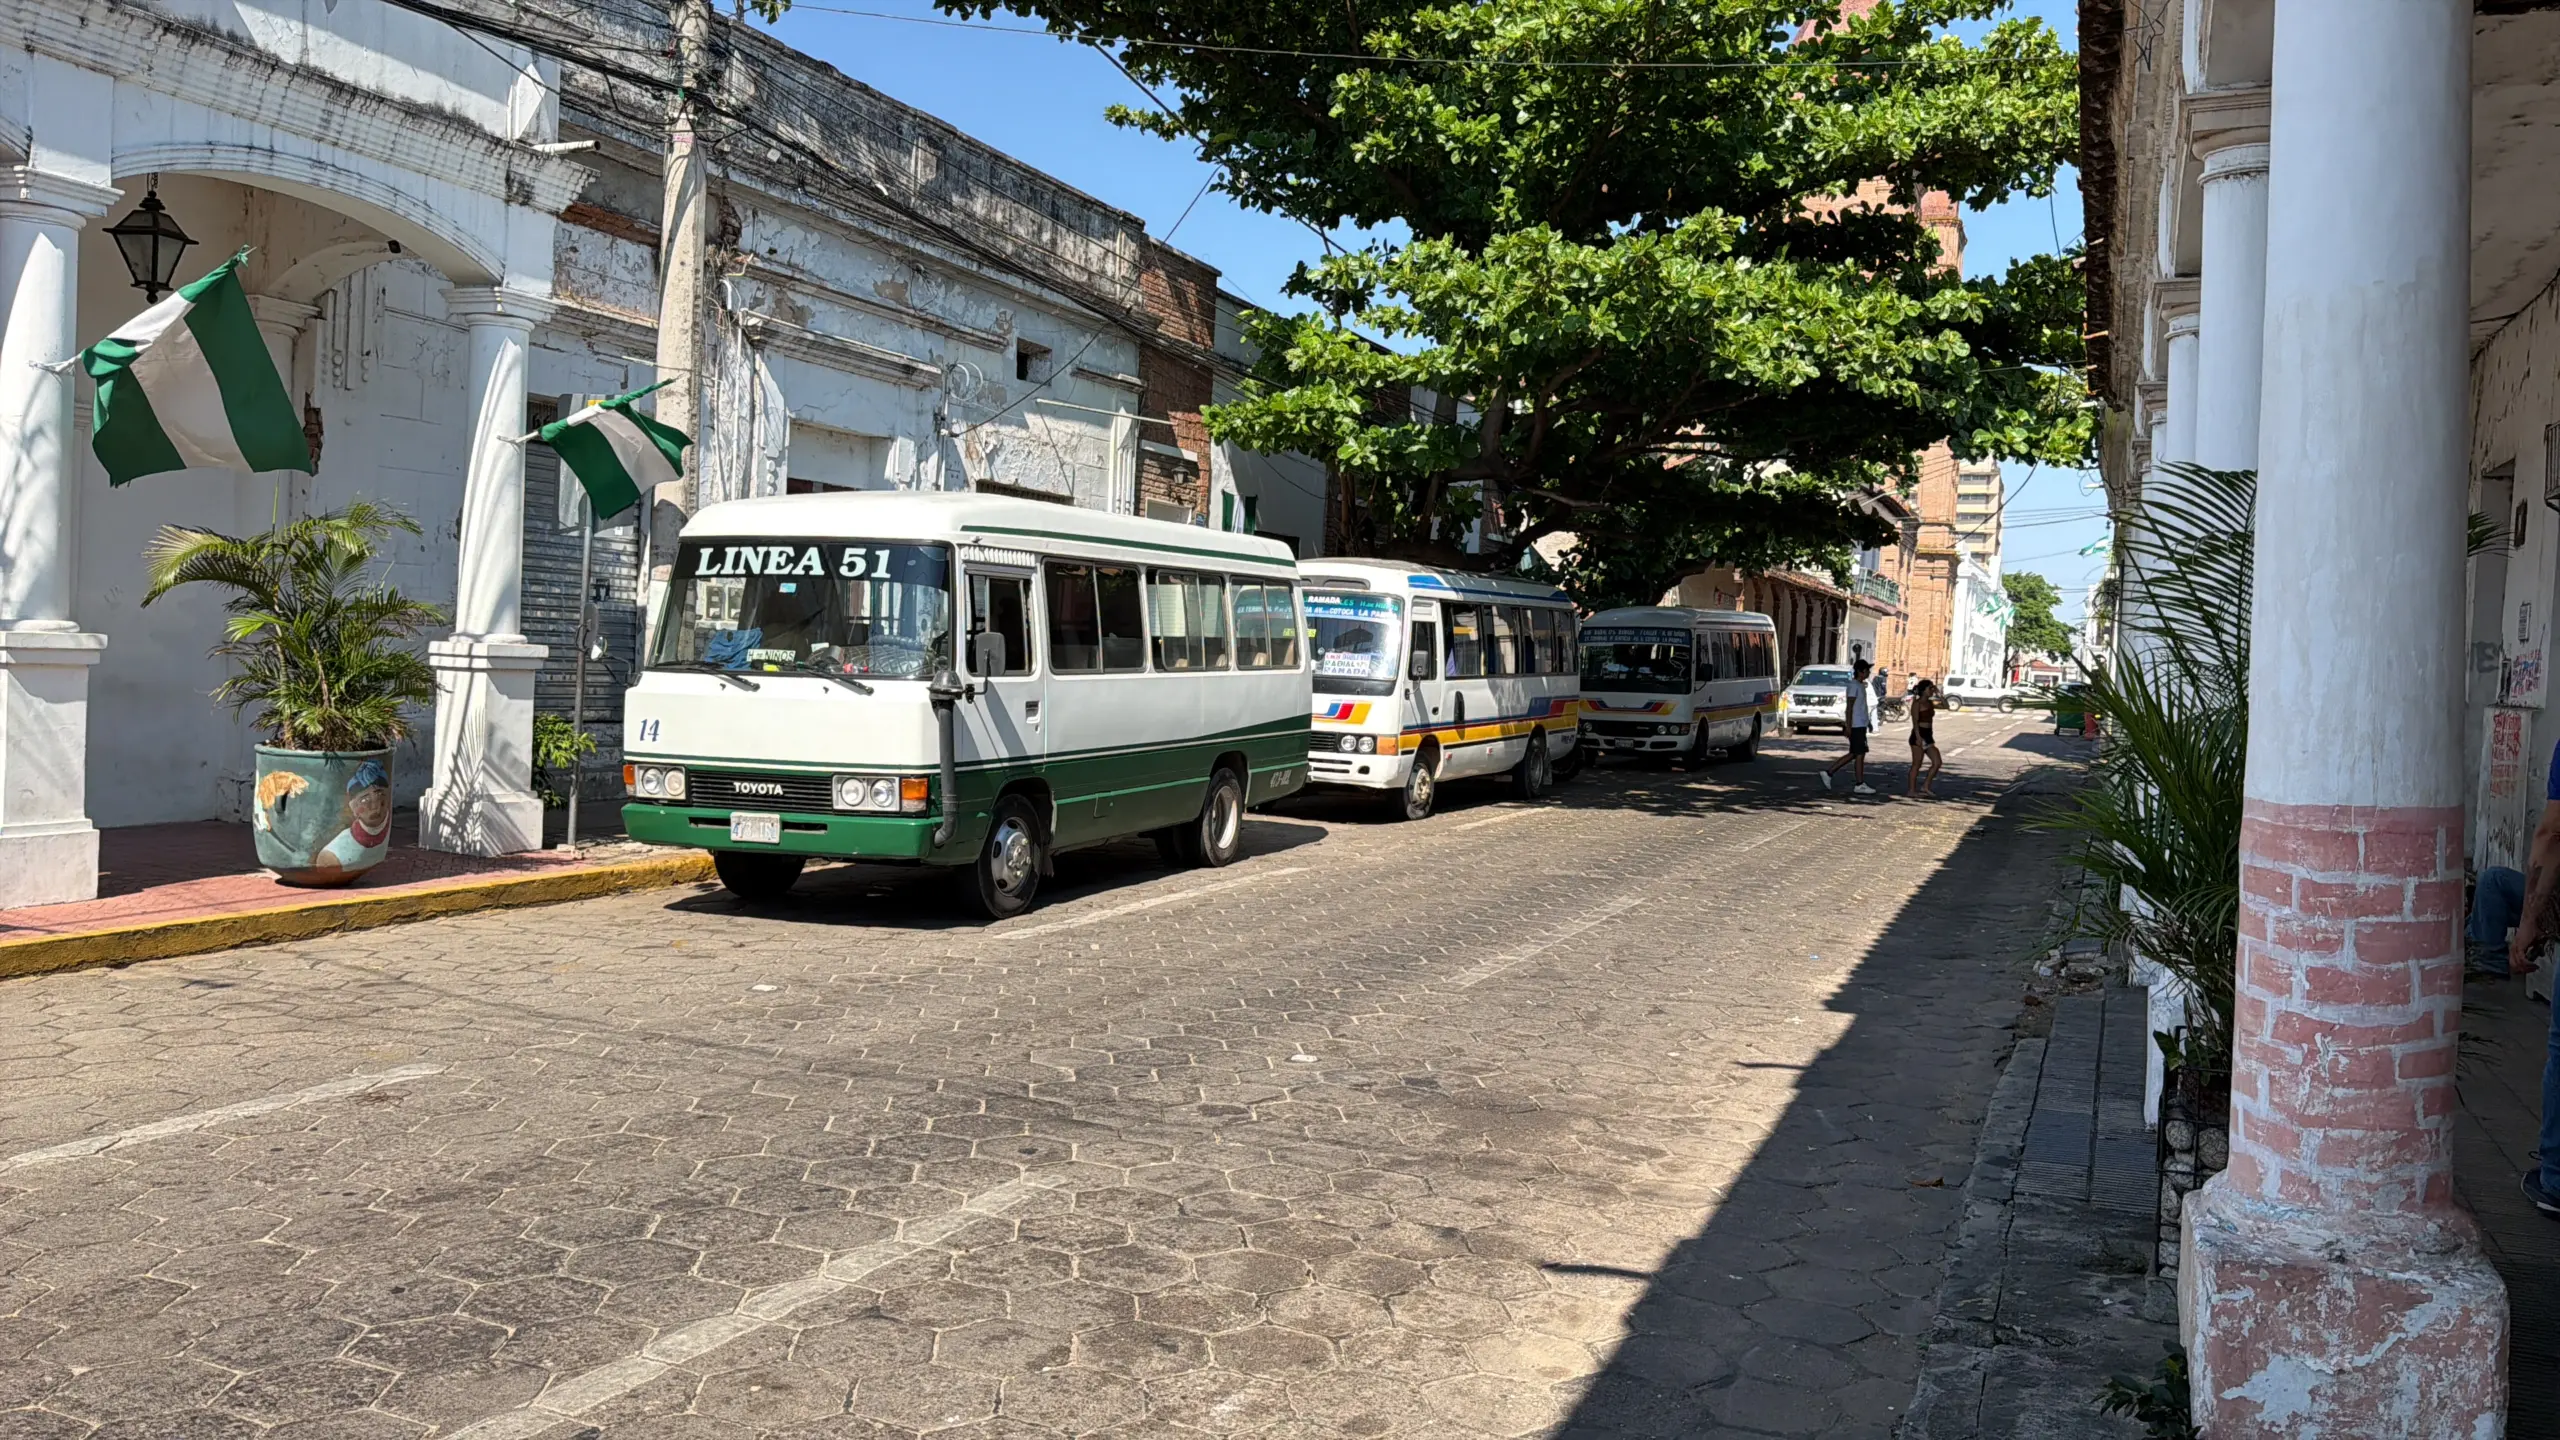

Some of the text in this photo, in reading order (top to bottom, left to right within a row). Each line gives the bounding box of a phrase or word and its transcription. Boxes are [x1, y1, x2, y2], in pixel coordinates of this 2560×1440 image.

[695, 546, 892, 579] LINEA 51
[1308, 595, 1341, 605] RAMADA
[1358, 608, 1369, 617] LA
[1324, 667, 1368, 676] RAMADA
[639, 718, 660, 742] 14
[733, 781, 783, 796] TOYOTA
